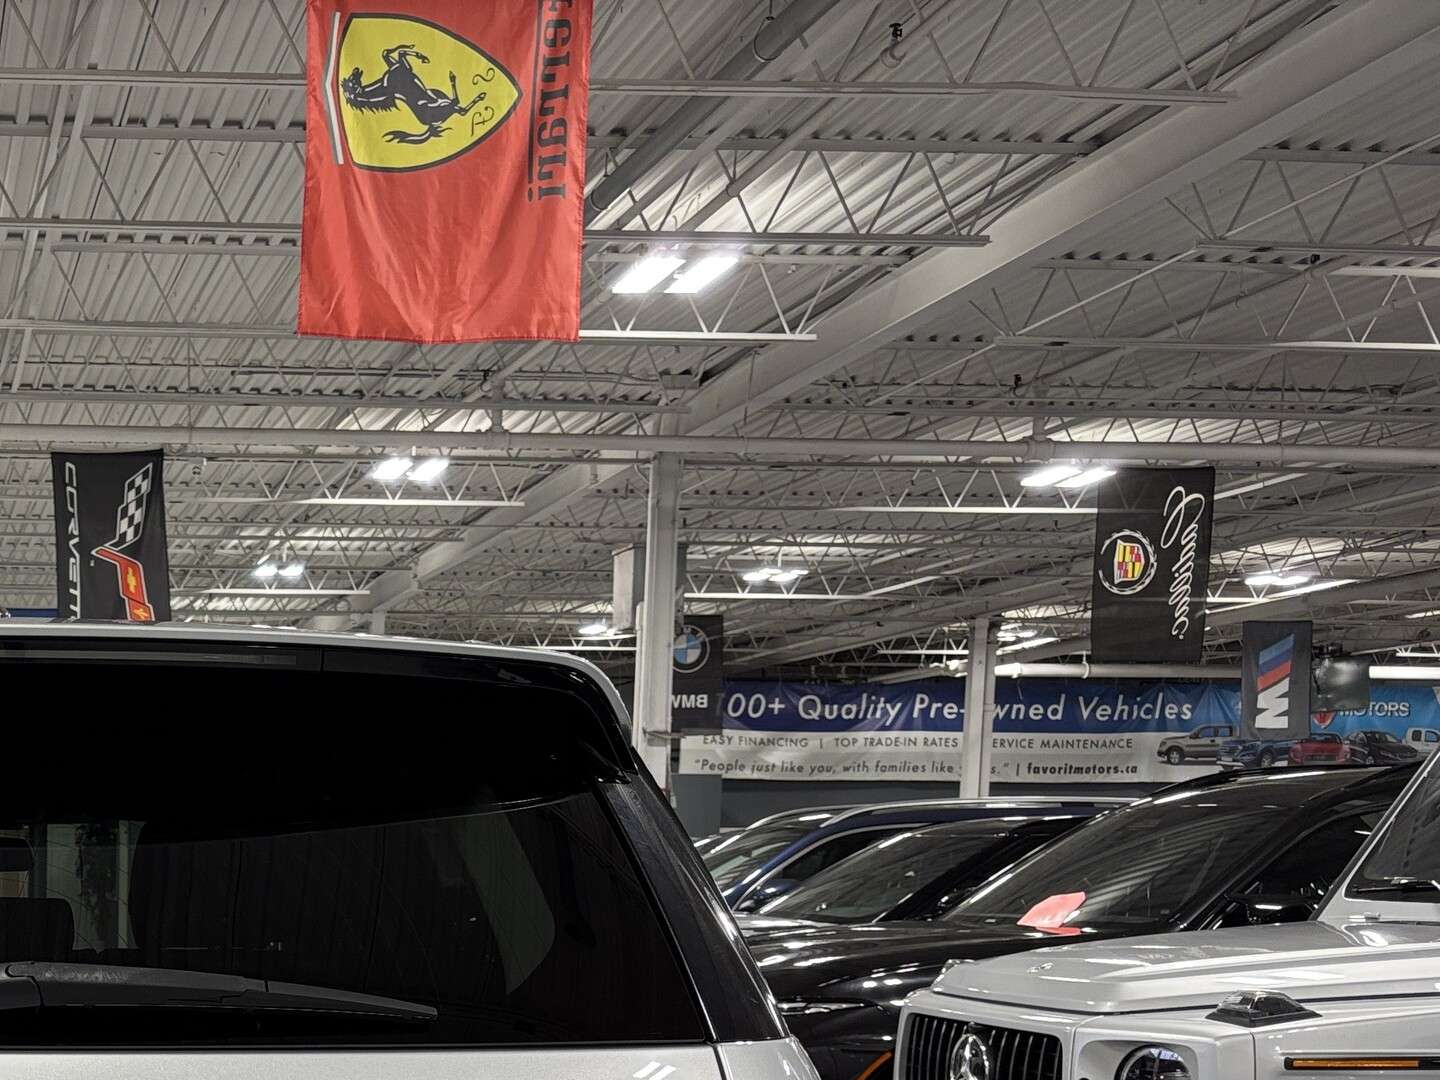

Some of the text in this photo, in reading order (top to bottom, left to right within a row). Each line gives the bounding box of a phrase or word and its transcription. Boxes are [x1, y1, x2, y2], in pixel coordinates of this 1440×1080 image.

[727, 692, 1192, 726] 00+ Quality Pre-wned Vehicles
[703, 736, 1133, 750] EASY FINANCING TOP TRADE-IN RATES ERVICE MAINTENANCE
[751, 761, 776, 775] just
[780, 760, 804, 773] like
[809, 764, 837, 776] you,
[842, 760, 869, 773] with
[875, 760, 927, 774] families
[931, 760, 954, 774] like
[1027, 762, 1138, 775] favoritmotors.ca
